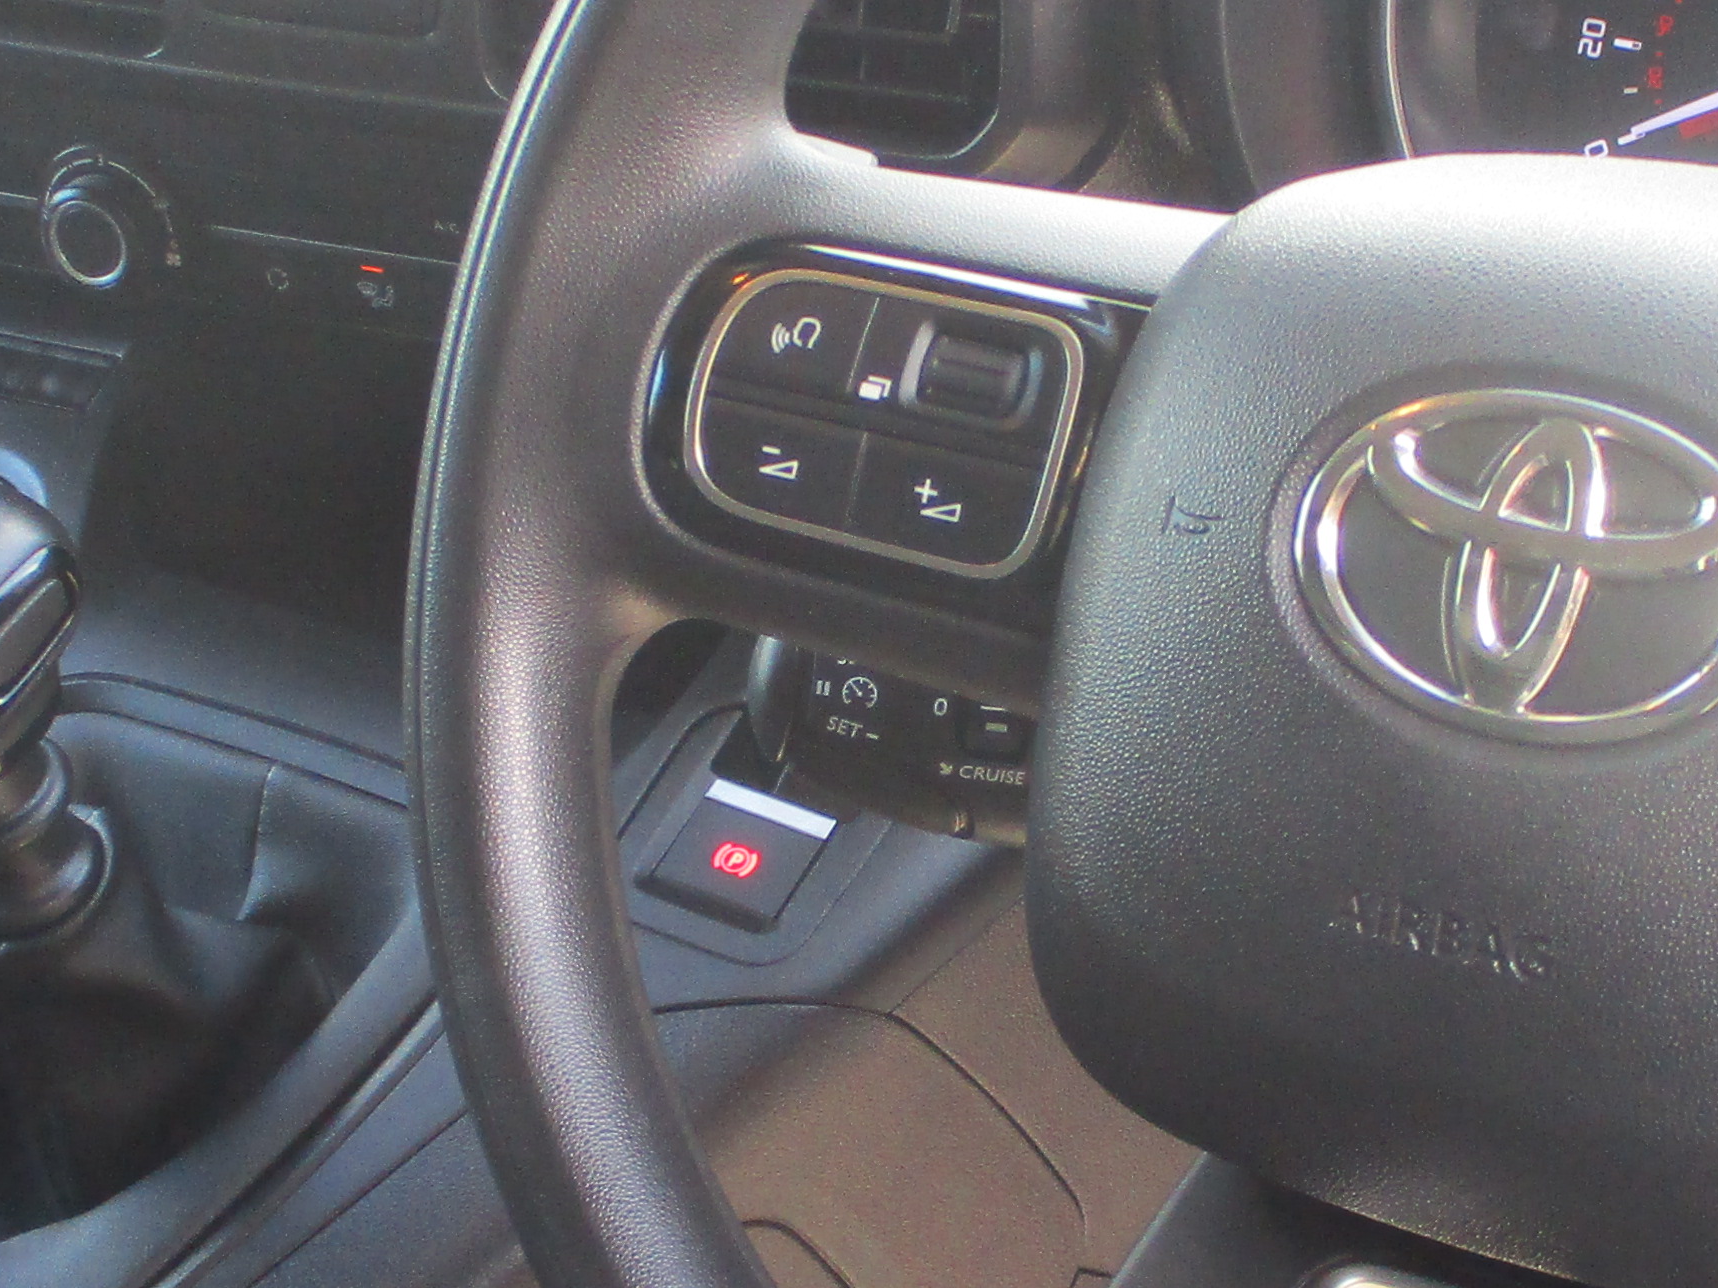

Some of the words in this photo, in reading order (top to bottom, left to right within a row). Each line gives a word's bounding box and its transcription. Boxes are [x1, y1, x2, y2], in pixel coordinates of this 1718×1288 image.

[1577, 16, 1607, 59] 20
[826, 716, 864, 739] SET
[959, 765, 1026, 786] CRUISE
